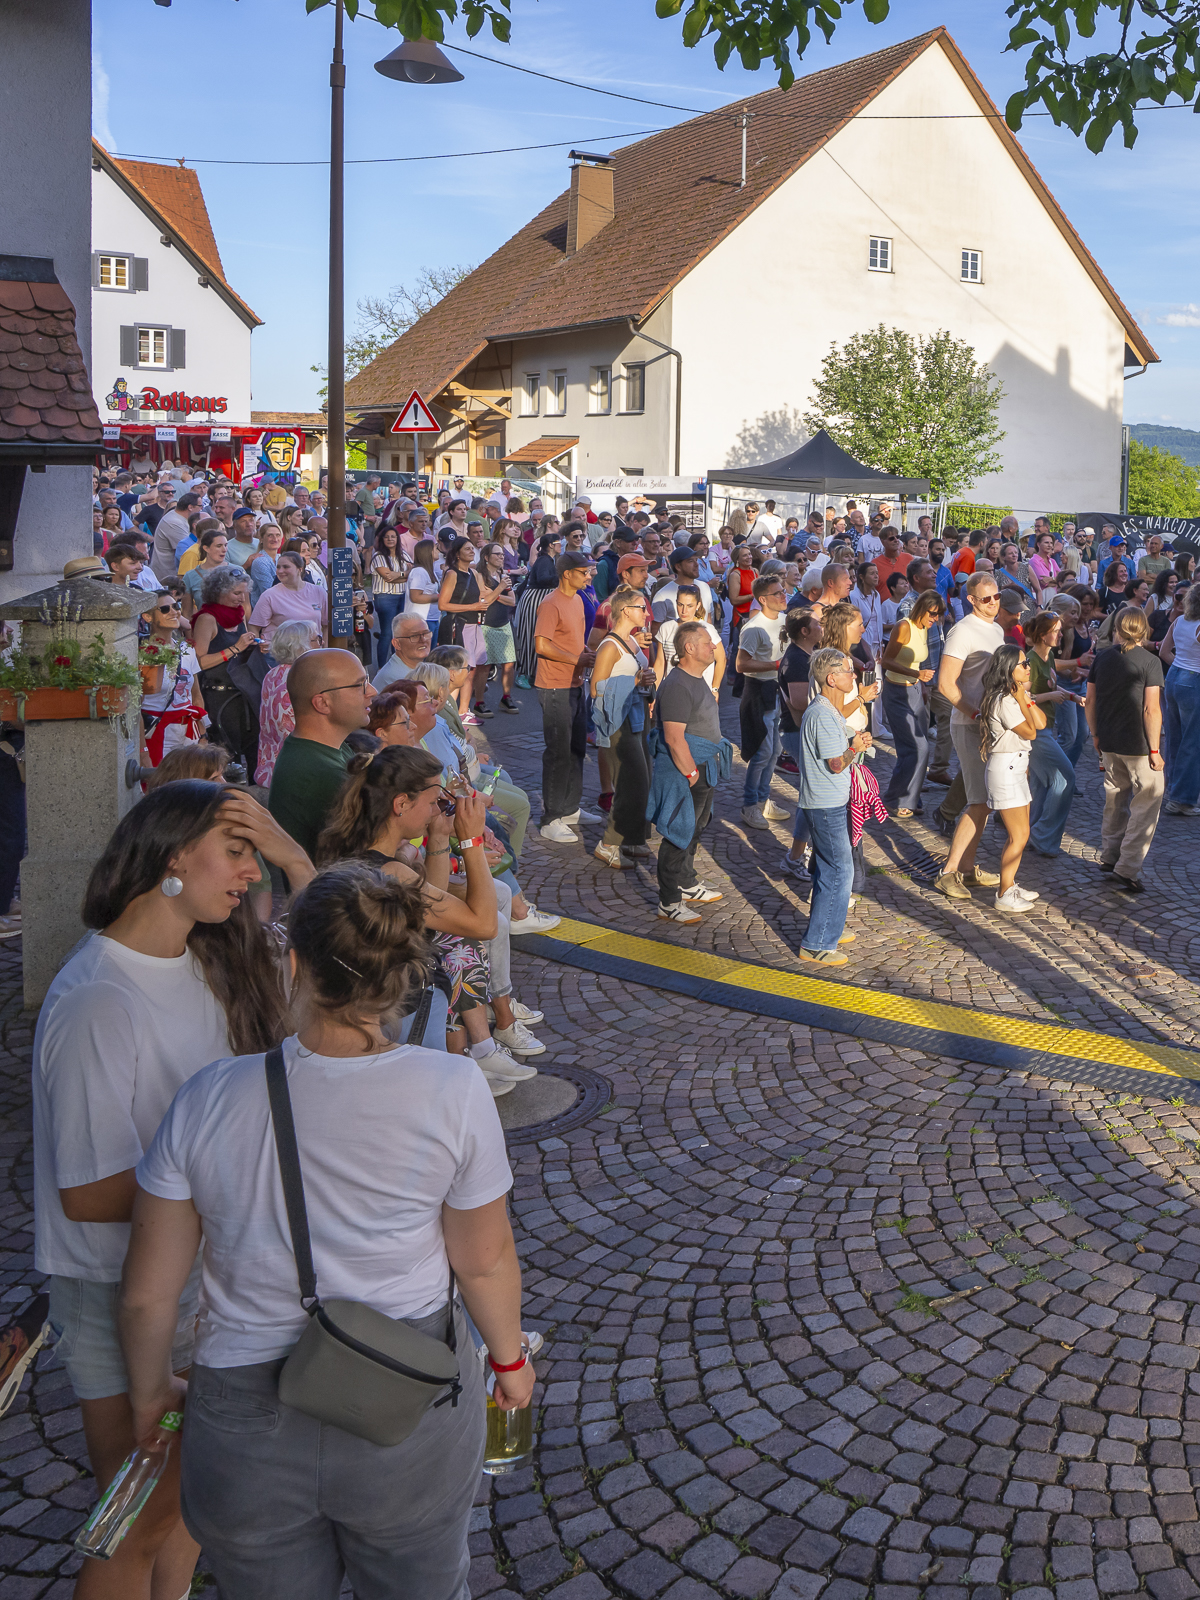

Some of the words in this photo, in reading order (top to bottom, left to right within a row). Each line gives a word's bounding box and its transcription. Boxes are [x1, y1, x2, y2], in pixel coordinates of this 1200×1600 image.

[139, 387, 228, 416] Rothaus
[586, 479, 623, 489] Breitenfeld
[1118, 518, 1138, 538] LES
